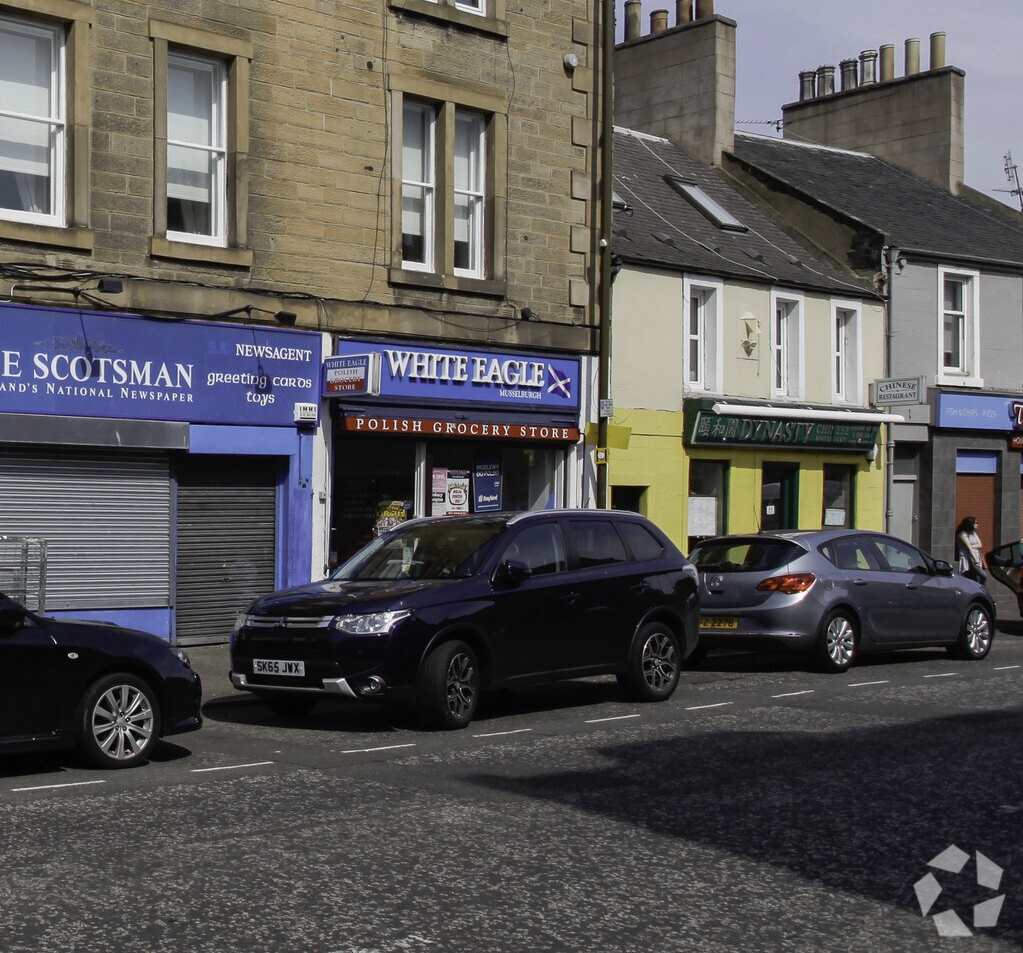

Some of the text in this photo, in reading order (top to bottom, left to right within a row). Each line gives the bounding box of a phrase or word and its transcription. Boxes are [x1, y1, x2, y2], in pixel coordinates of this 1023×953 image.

[235, 343, 312, 362] NEWSAGENT
[32, 353, 194, 389] SCOTSMAN
[326, 358, 367, 368] WHITE EAGLE
[383, 349, 545, 388] WHITE EAGLE
[207, 371, 312, 389] greeting cards
[879, 381, 917, 393] CHINESE
[46, 382, 114, 398] NATIONAL
[120, 388, 195, 403] NEWSPAPER
[246, 391, 275, 406] toys
[499, 389, 542, 399] MUSSELBURGH
[878, 392, 917, 400] RESTAURANT
[356, 417, 569, 439] POLISH GROCERY STORE
[739, 418, 815, 443] DYNASTY
[256, 660, 300, 674] SK65 JWX
